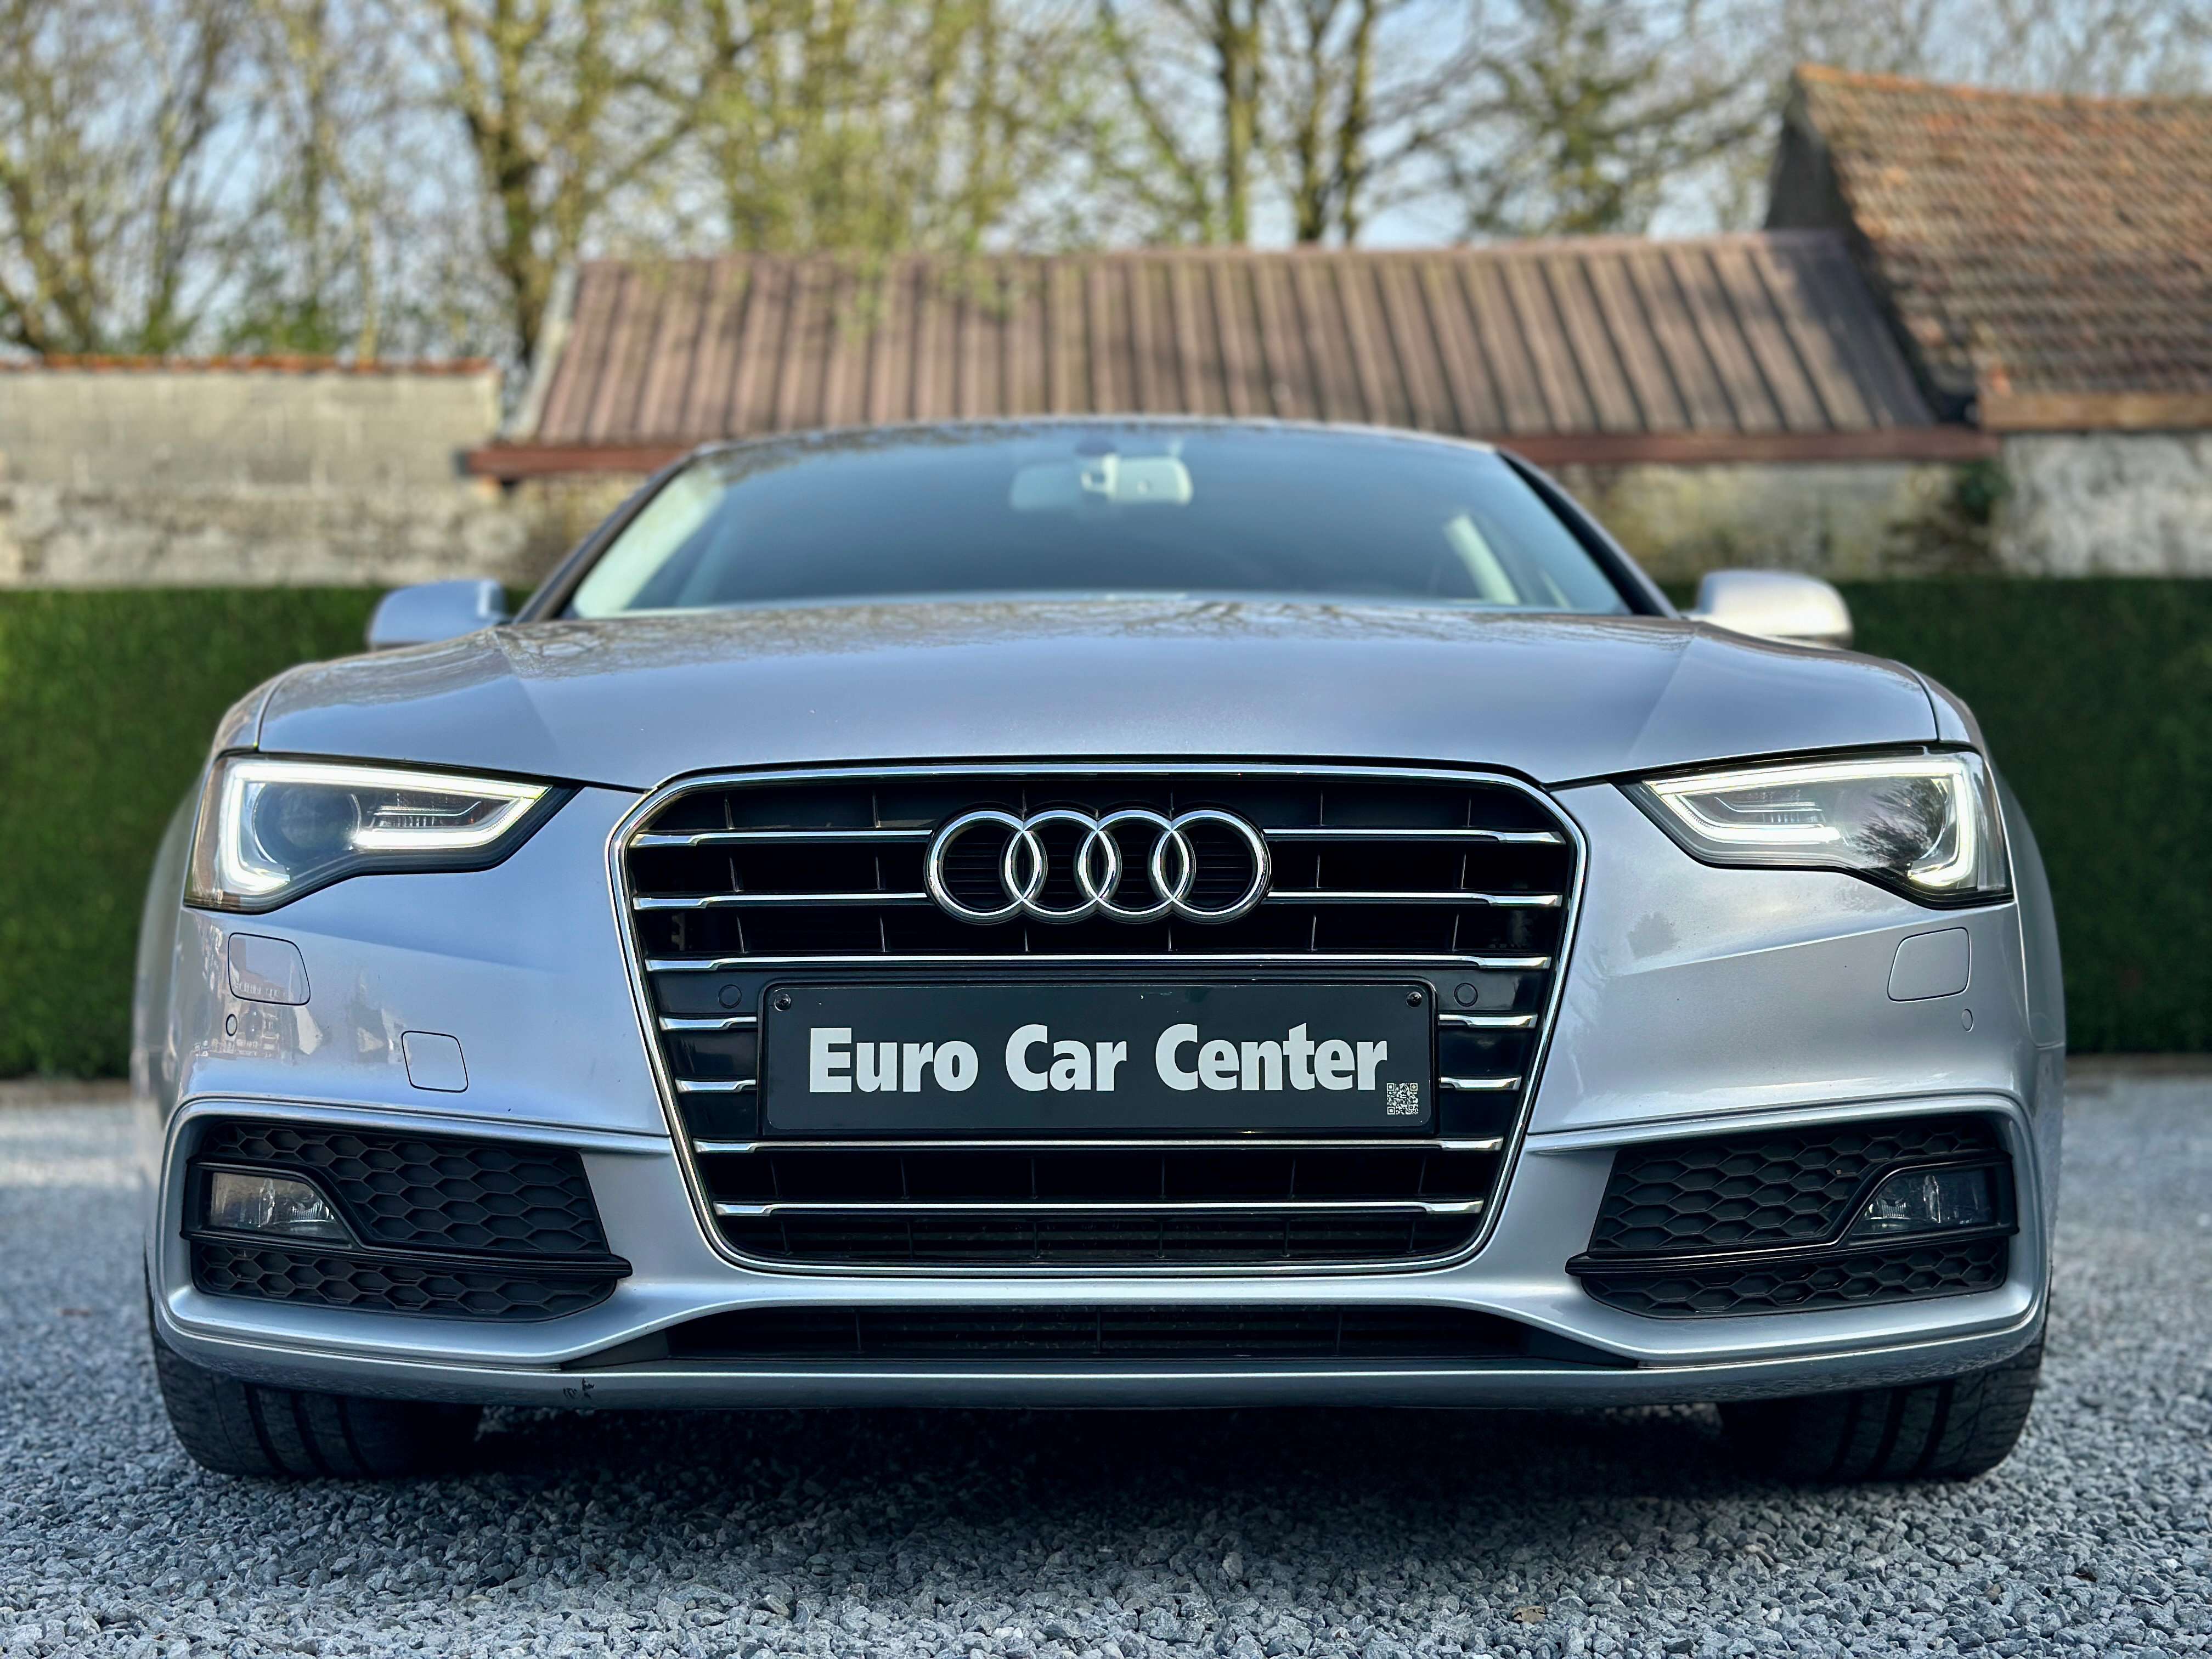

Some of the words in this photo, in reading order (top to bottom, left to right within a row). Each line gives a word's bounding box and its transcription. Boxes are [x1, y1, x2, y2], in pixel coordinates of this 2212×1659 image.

[809, 1027, 978, 1093] Euro
[1005, 1023, 1127, 1092] Car
[1155, 1023, 1387, 1091] Center
